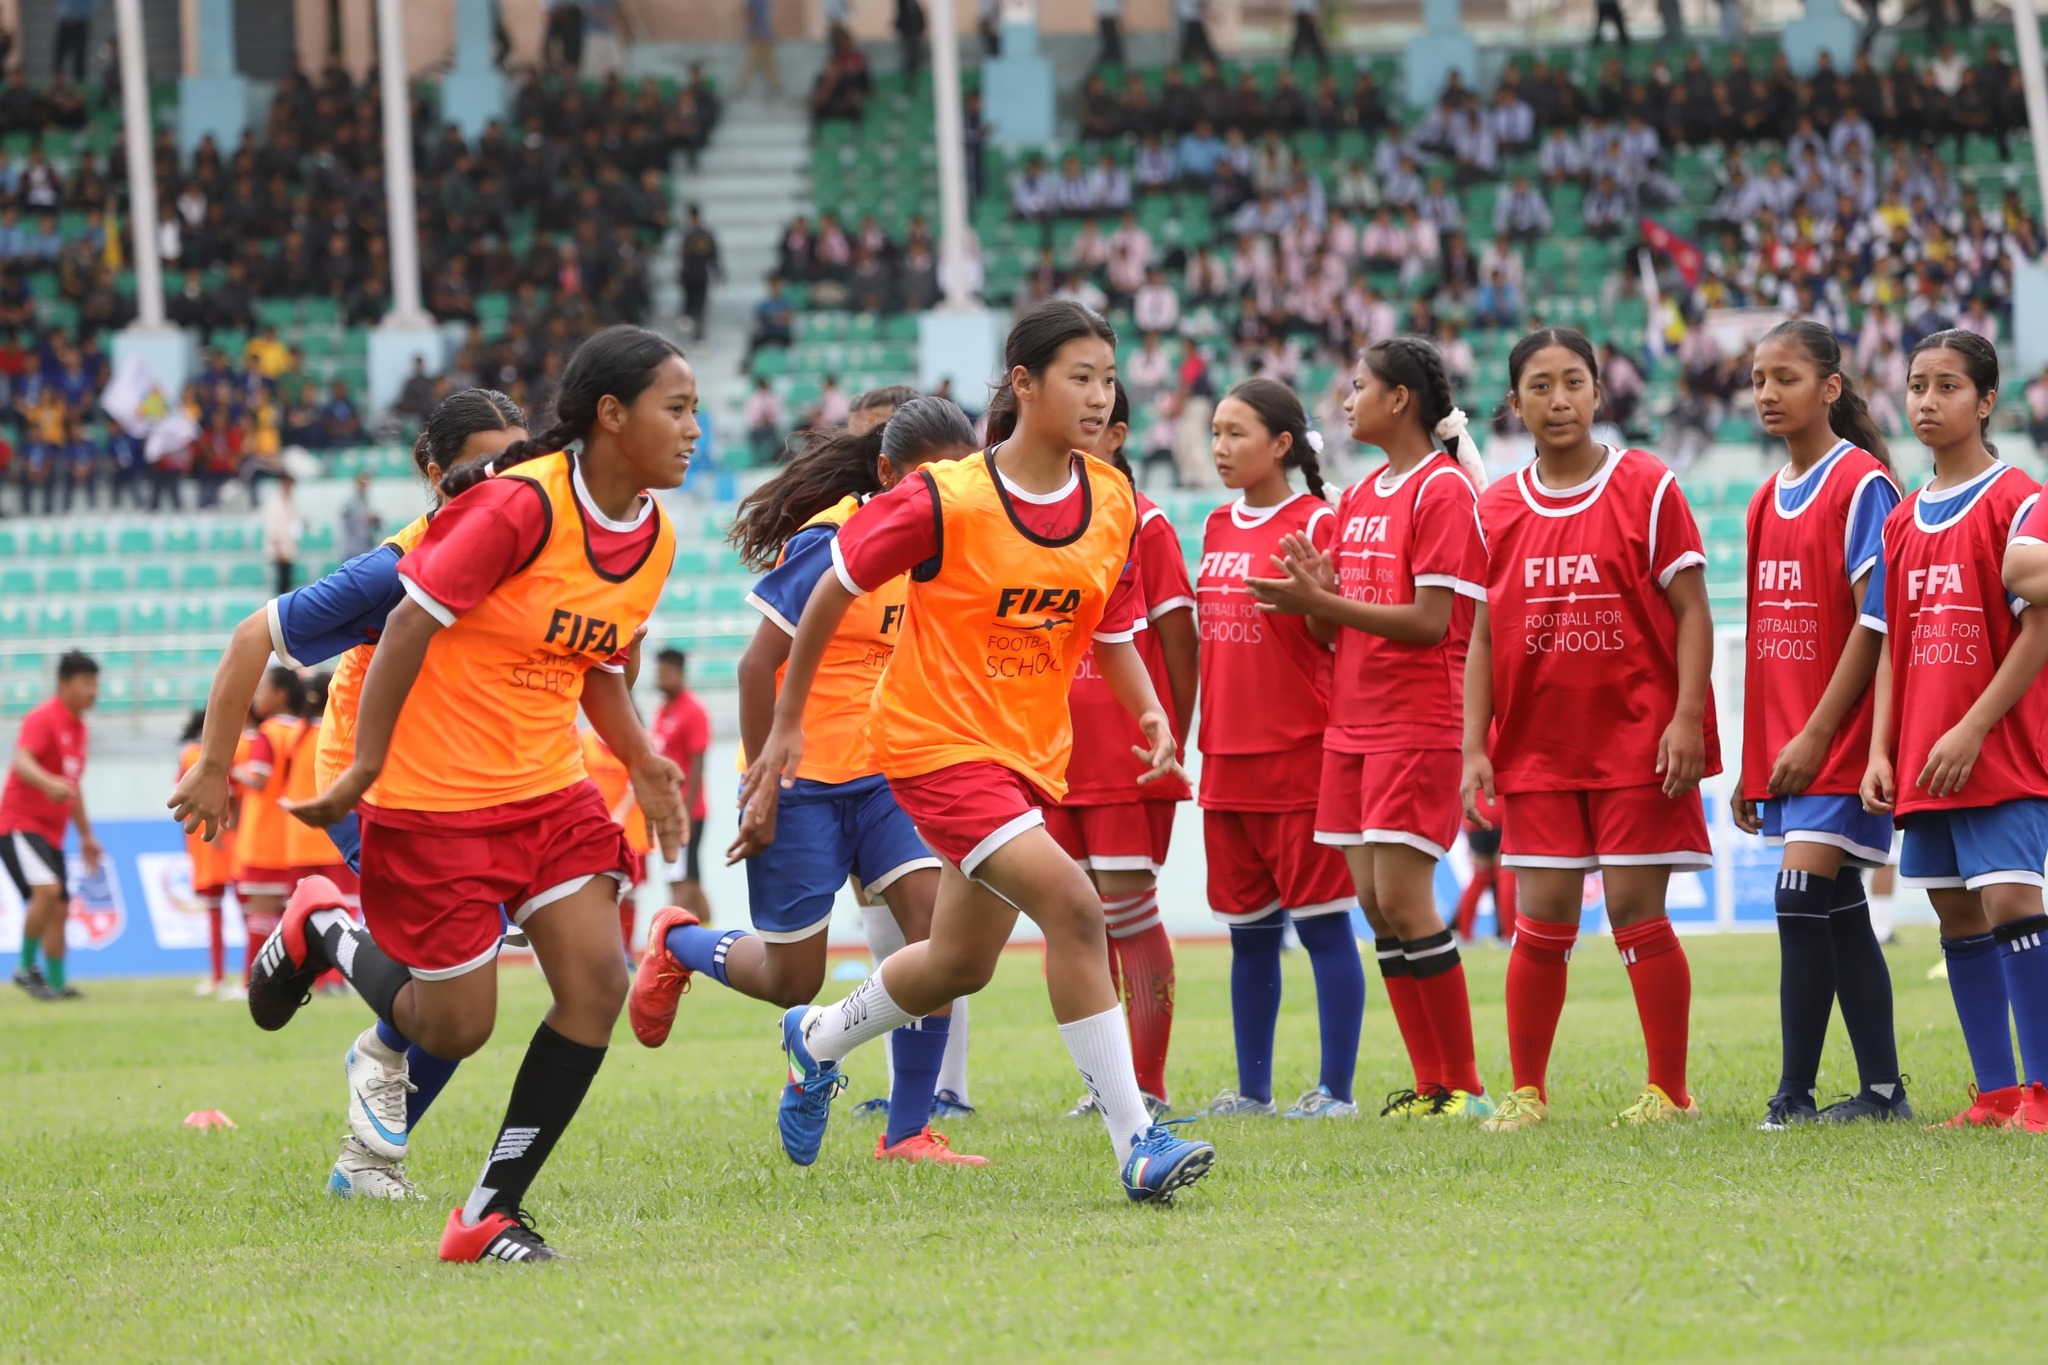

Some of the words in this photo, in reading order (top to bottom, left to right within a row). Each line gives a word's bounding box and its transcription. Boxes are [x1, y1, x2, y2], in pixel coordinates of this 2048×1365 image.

[1342, 515, 1388, 542] FIFA
[1198, 552, 1250, 578] FIFA
[1376, 568, 1394, 582] FOR
[1524, 554, 1600, 588] FIFA
[1758, 560, 1802, 591] FIFA
[1908, 563, 1963, 601] FFA
[996, 588, 1081, 617] FIFA
[544, 608, 617, 655] FIFA
[1200, 621, 1262, 644] CHOOLS
[1525, 612, 1591, 629] FOOTBALL
[1595, 610, 1623, 625] FOR
[1951, 622, 1980, 639] FOR
[988, 635, 1051, 651] FOOTBA
[1525, 629, 1625, 655] SCHOOLS
[1909, 643, 1978, 666] HOOLS
[508, 666, 575, 693] SCHO
